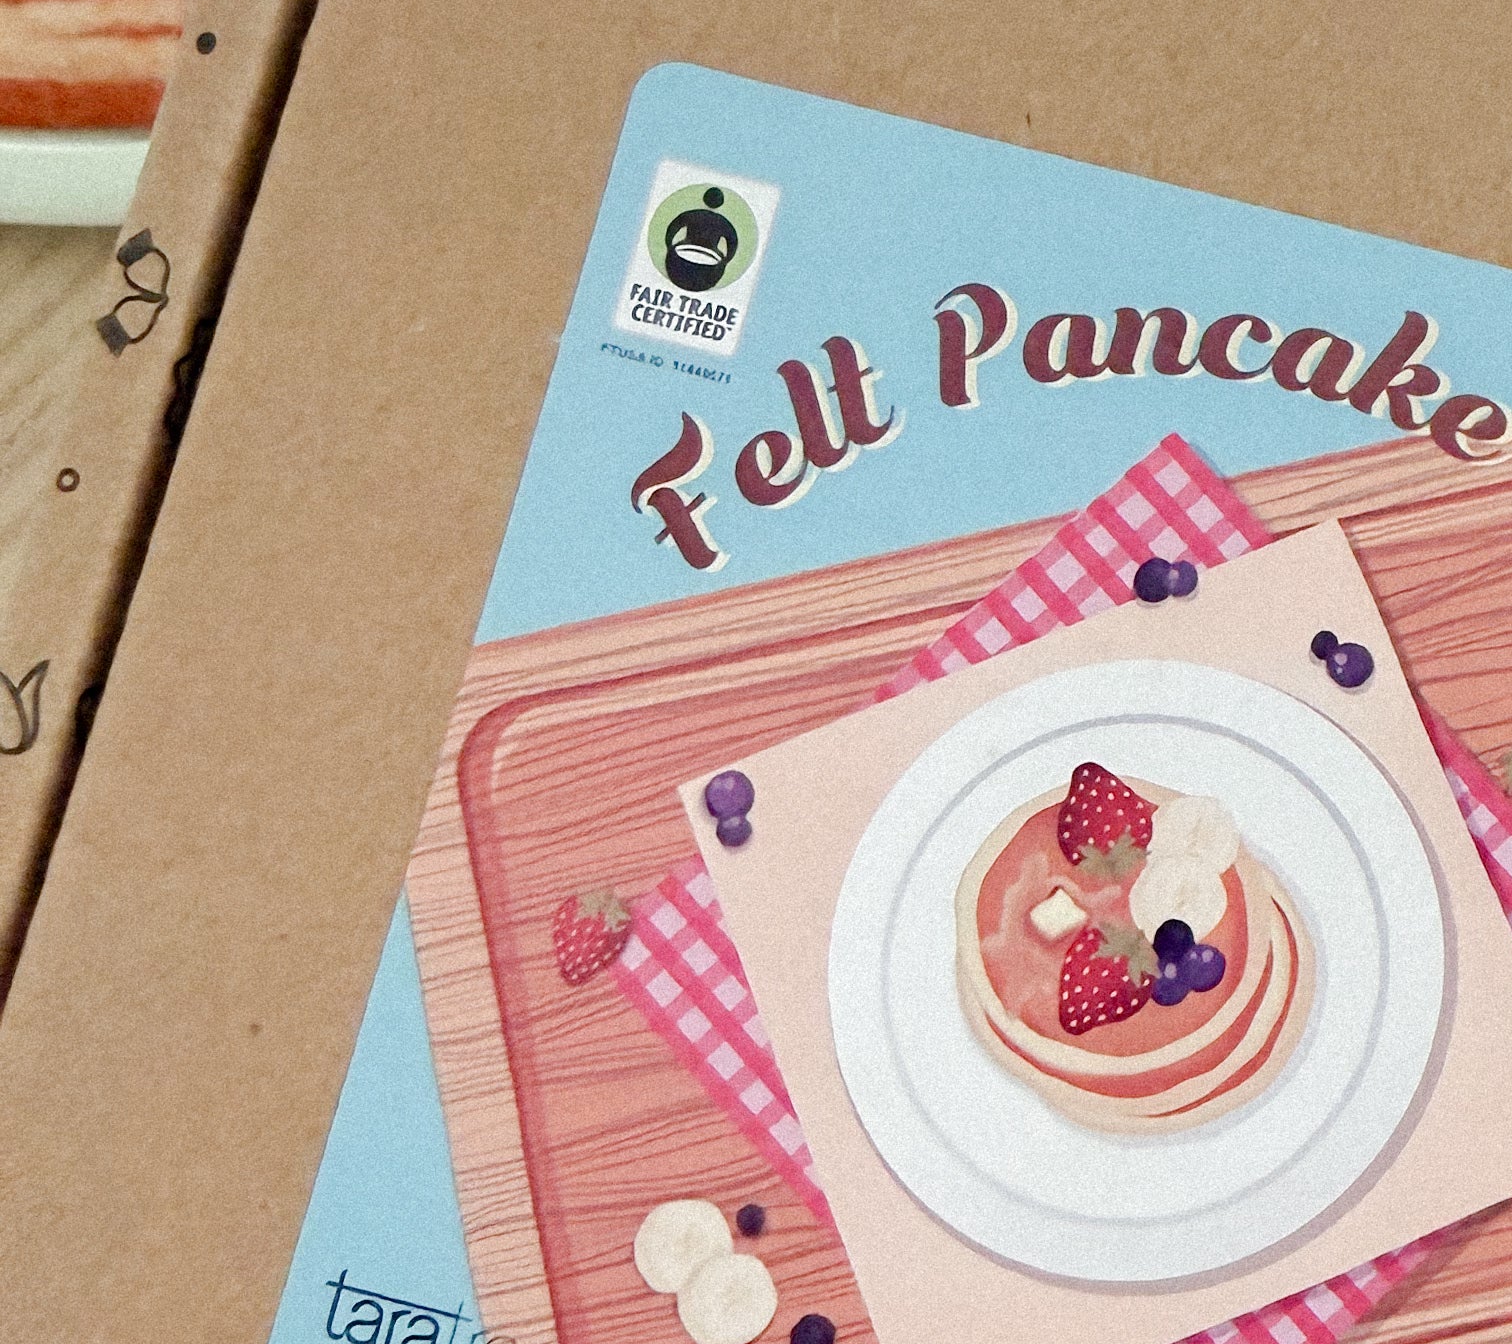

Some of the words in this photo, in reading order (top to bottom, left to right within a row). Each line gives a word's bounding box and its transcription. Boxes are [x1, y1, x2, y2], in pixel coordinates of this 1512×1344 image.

[630, 283, 671, 310] FAIR
[680, 294, 739, 326] TRADE
[631, 303, 733, 341] CERTIFIED
[631, 335, 901, 572] Felt
